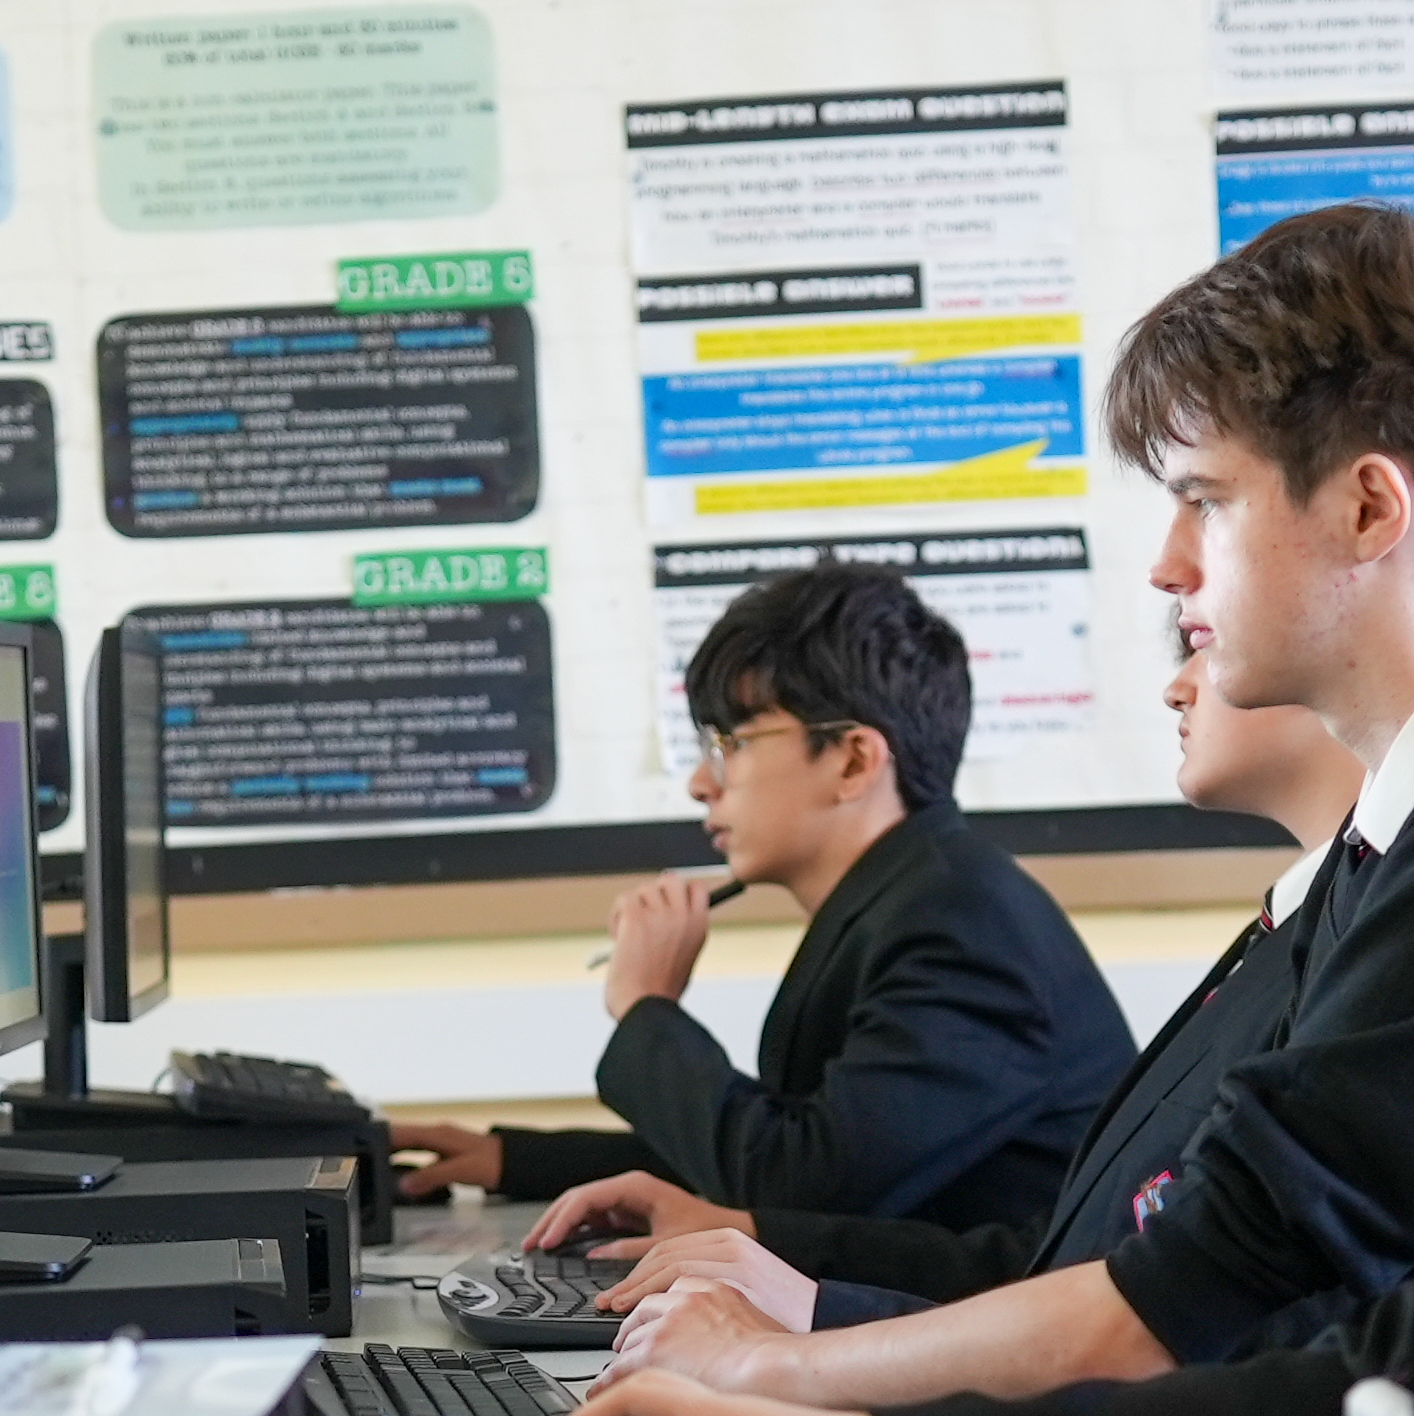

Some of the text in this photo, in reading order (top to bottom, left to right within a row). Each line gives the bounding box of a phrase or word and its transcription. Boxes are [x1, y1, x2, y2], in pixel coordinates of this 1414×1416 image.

[339, 259, 493, 300] GRADE
[355, 552, 545, 596] GRADE 2
